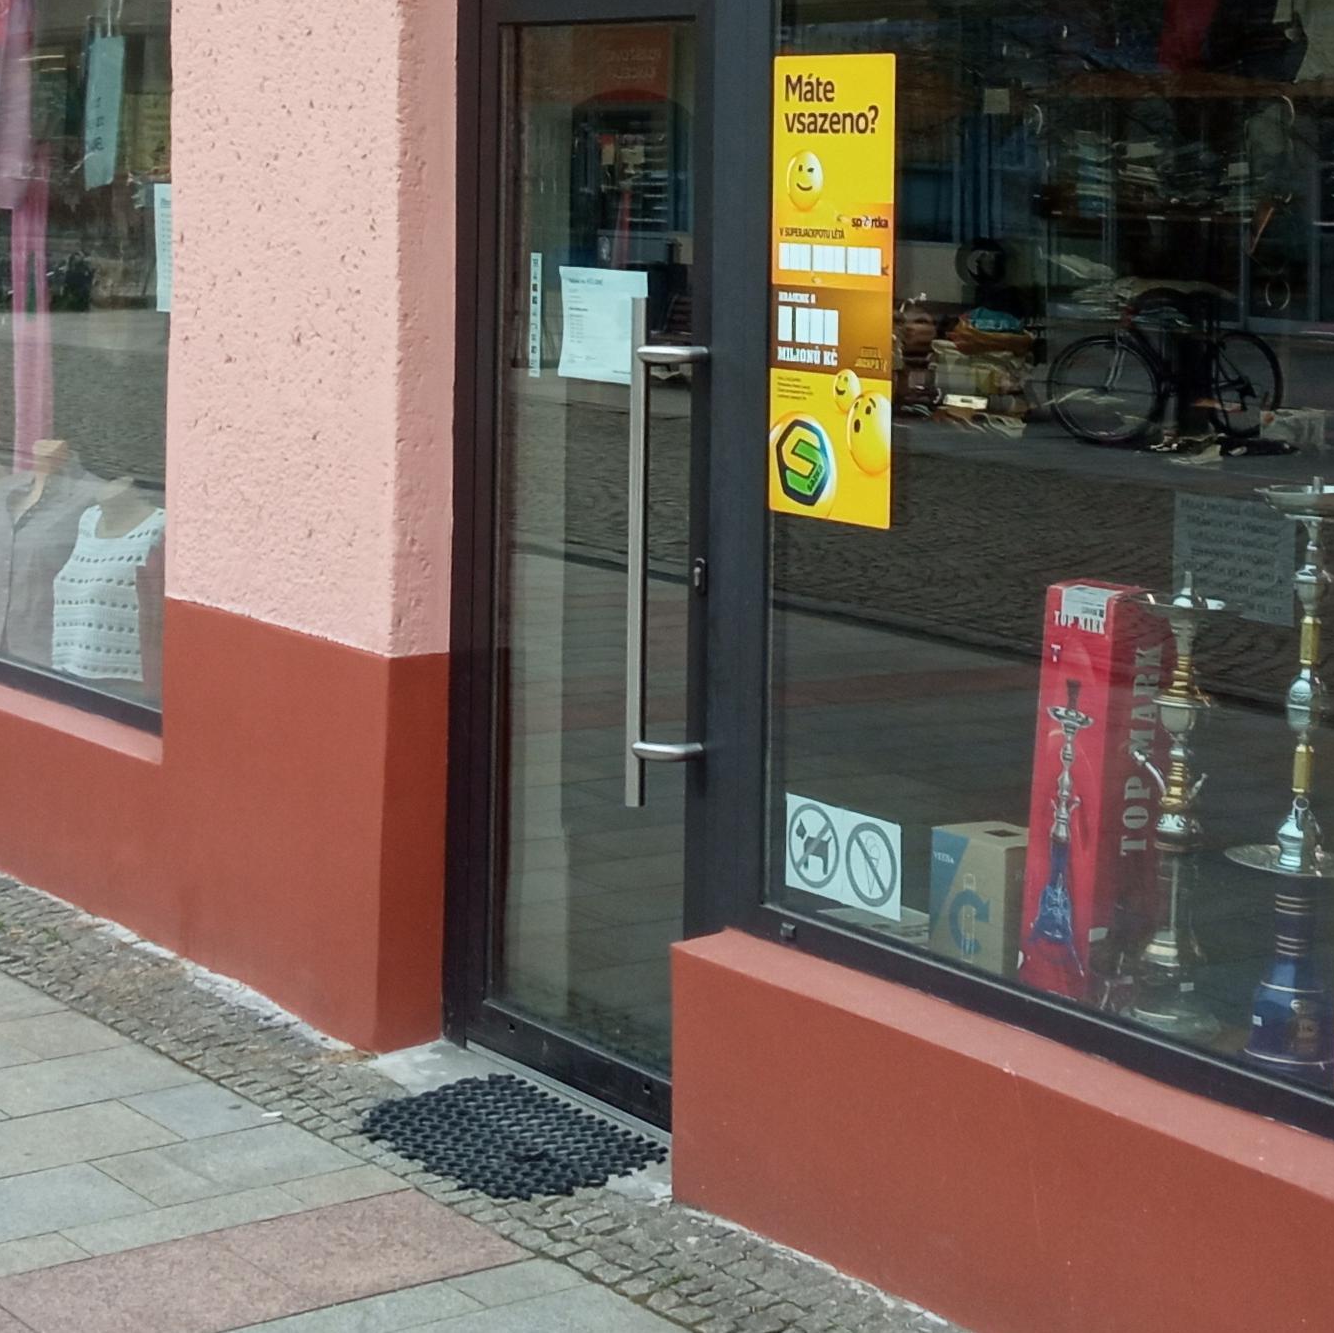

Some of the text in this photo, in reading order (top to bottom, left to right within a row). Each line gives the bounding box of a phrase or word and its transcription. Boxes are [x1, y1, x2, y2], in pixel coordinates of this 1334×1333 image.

[784, 73, 835, 103] Máte
[784, 104, 880, 134] vsazeno?
[1119, 775, 1152, 857] TOP
